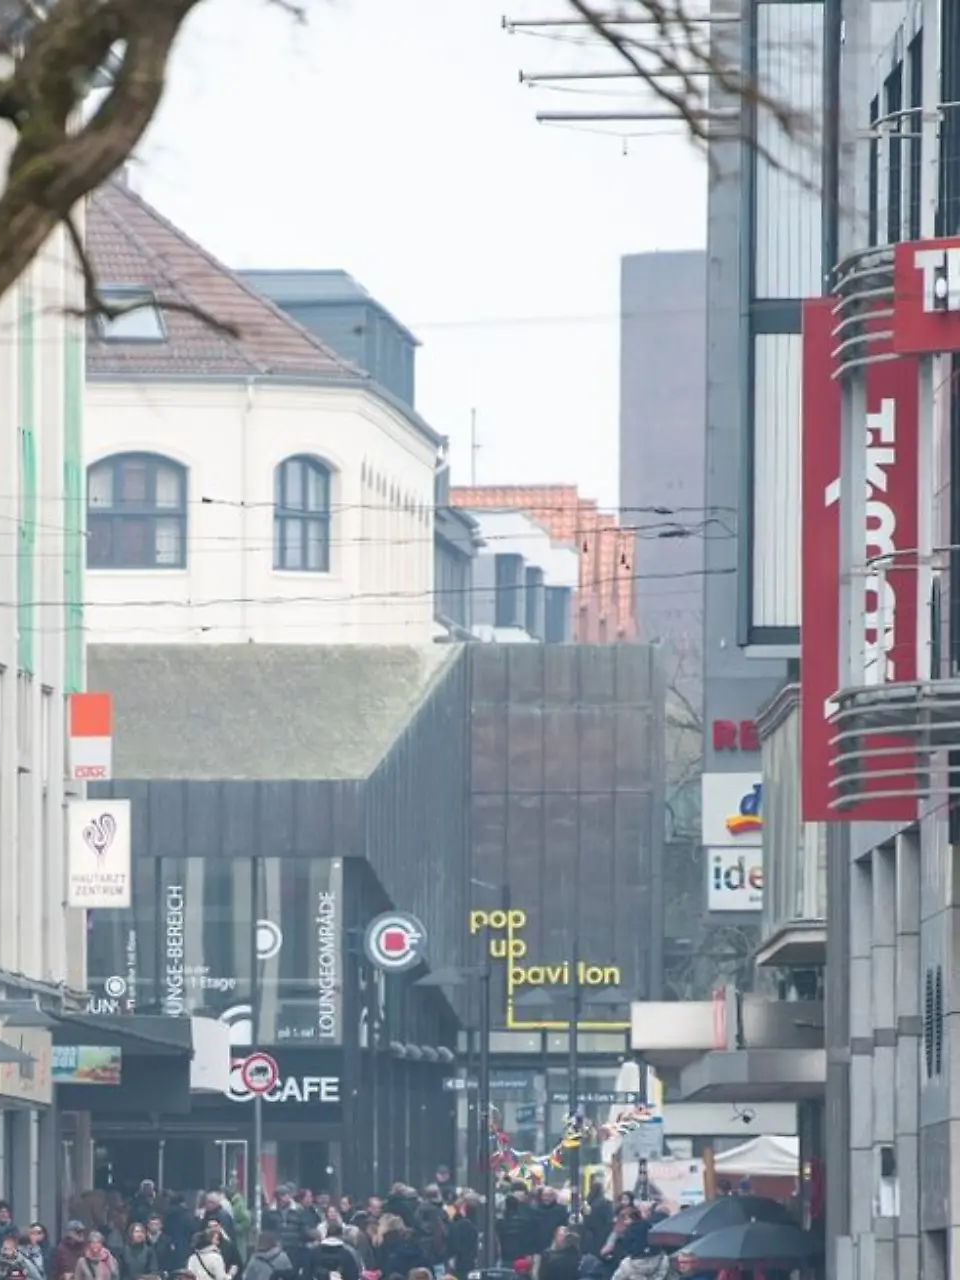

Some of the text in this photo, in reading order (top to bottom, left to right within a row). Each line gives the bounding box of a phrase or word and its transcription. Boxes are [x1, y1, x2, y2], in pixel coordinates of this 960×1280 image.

[74, 885, 124, 896] ZENTRUM
[470, 909, 527, 934] pop
[166, 885, 183, 1017] UNGE-BEREICH
[489, 938, 528, 958] up
[508, 960, 621, 990] pavilon
[261, 1076, 340, 1102] CAFE
